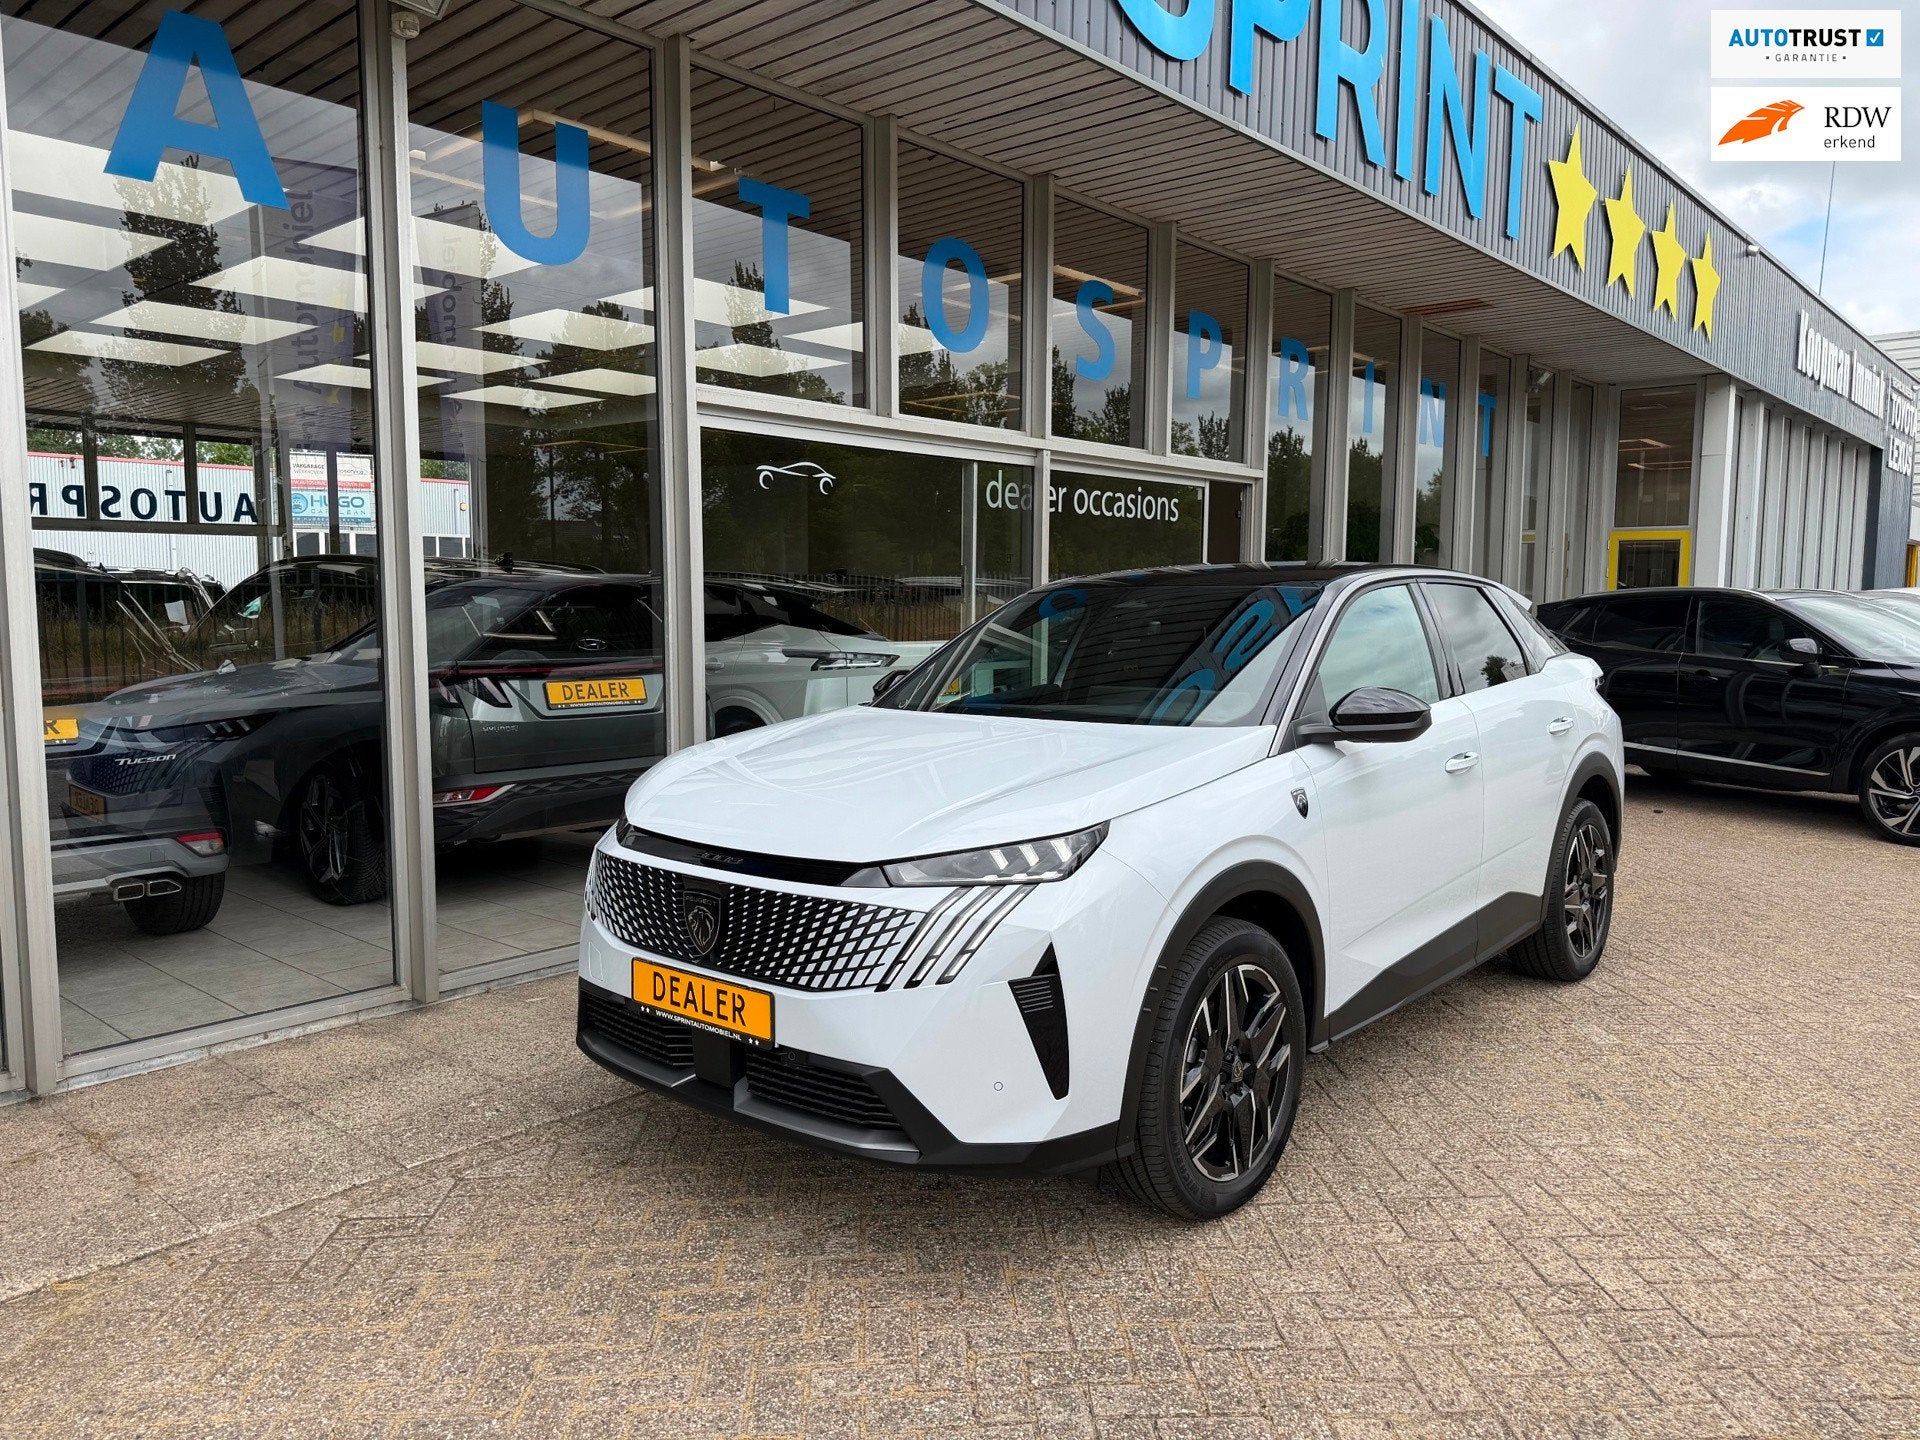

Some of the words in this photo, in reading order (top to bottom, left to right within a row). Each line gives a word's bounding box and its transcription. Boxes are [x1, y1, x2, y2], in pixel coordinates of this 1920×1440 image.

[1117, 0, 1543, 240] RINT
[1890, 393, 1918, 438] TOYOTA
[1888, 434, 1912, 477] LEXUS
[986, 470, 1067, 513] deaer
[1073, 486, 1179, 522] occasions
[562, 682, 630, 701] DEALER
[115, 753, 177, 766] TUCSON
[653, 971, 746, 1027] DEALER
[655, 1009, 742, 1041] WWW.SPRINTAUTOMOBIEL.NL
